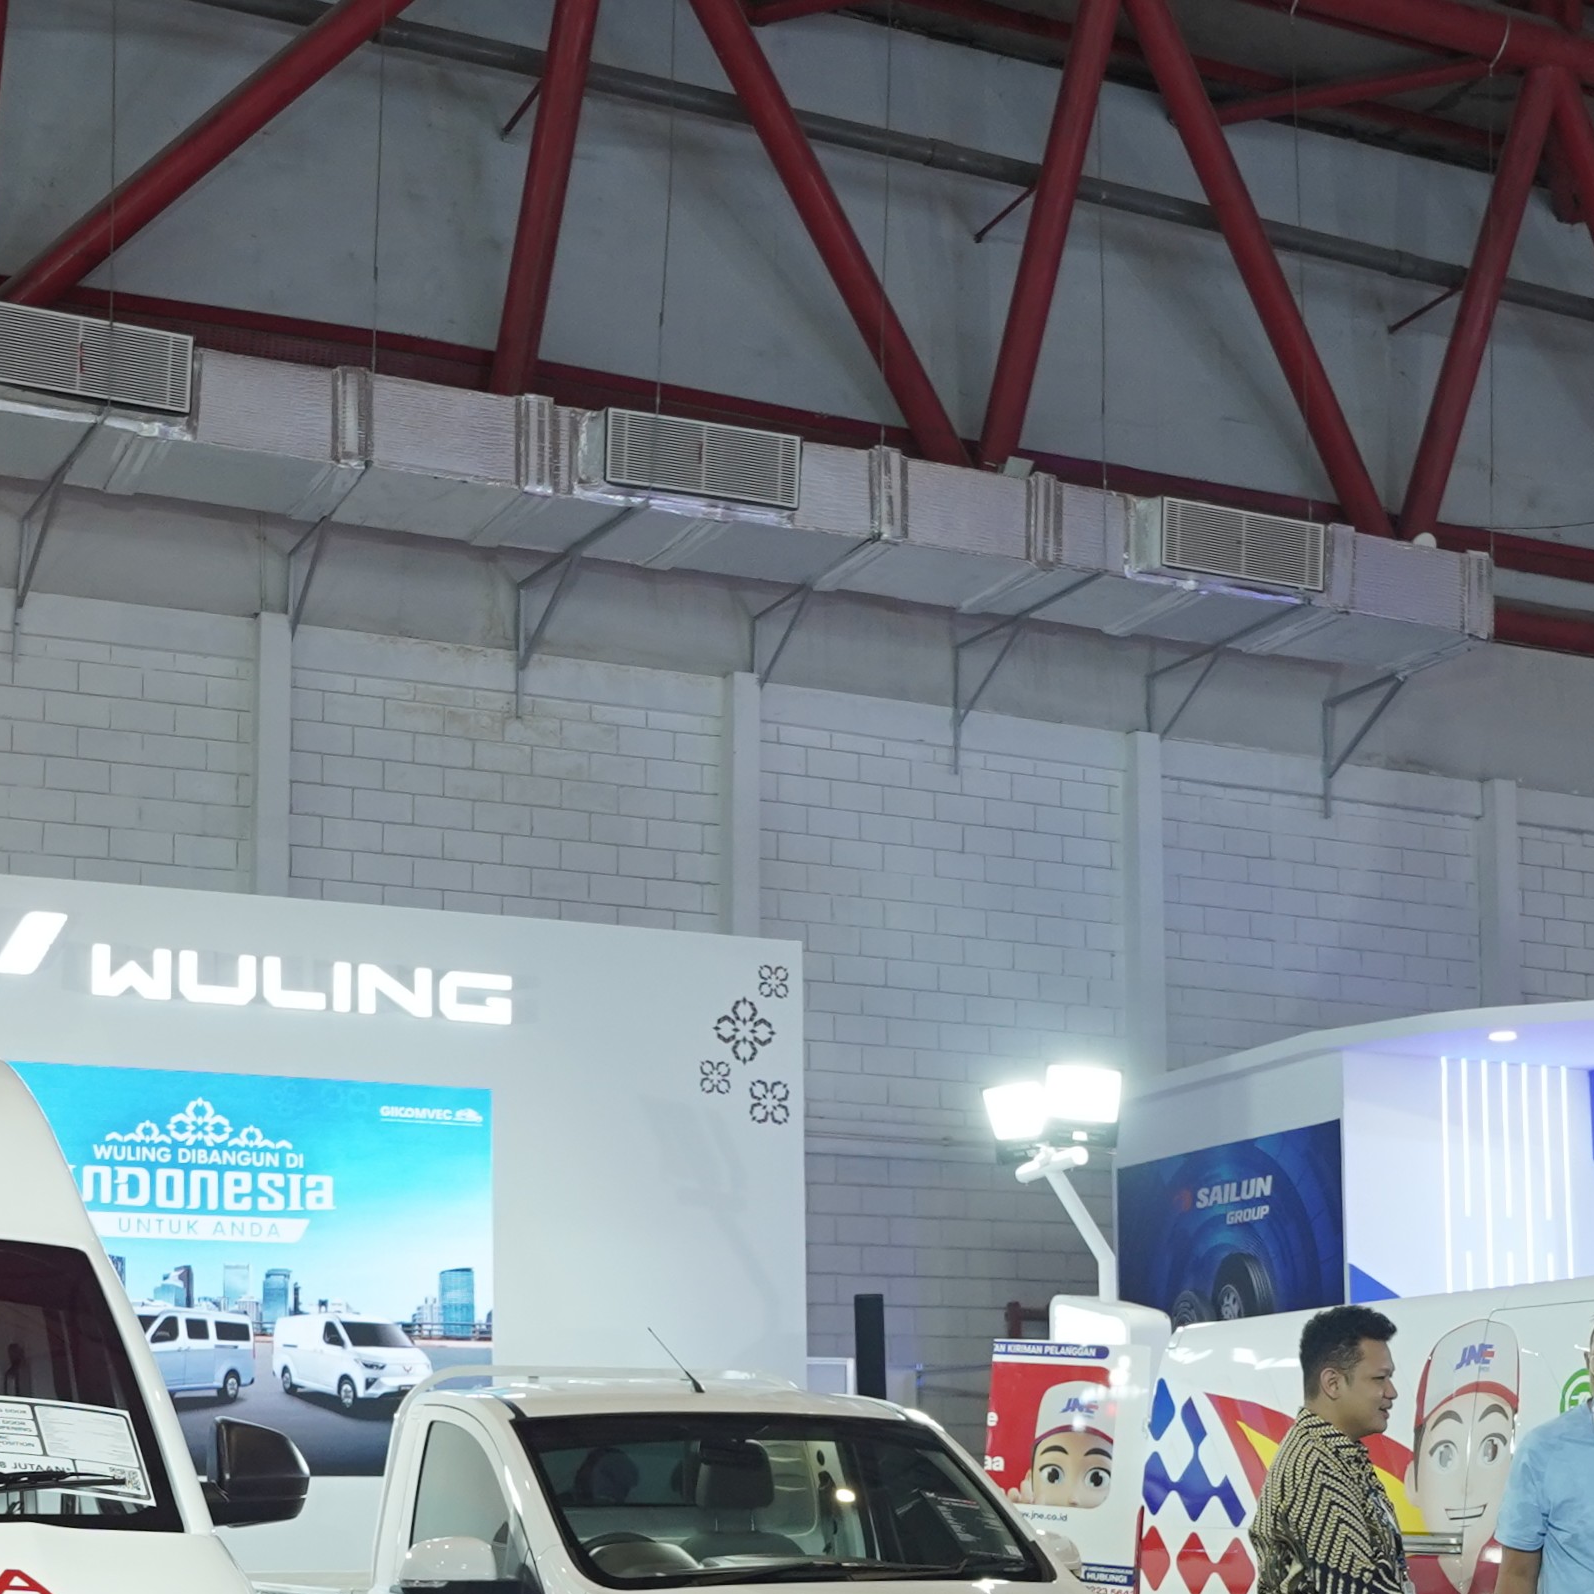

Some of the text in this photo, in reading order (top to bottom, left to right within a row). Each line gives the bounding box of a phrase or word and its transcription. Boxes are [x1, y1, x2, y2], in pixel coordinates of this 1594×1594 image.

[91, 943, 513, 1025] WULING
[93, 1144, 305, 1168] WULING DIBANGUN DI
[1195, 1174, 1273, 1209] SAILUN
[1225, 1204, 1270, 1225] GROUP
[118, 1217, 282, 1239] UNTUK ANDA
[1007, 1343, 1043, 1354] KIRIMAN
[1044, 1345, 1096, 1357] PELANGGAN
[1454, 1343, 1495, 1371] JNE
[1060, 1397, 1099, 1414] JNE
[1086, 1573, 1128, 1584] HUBUNGI
